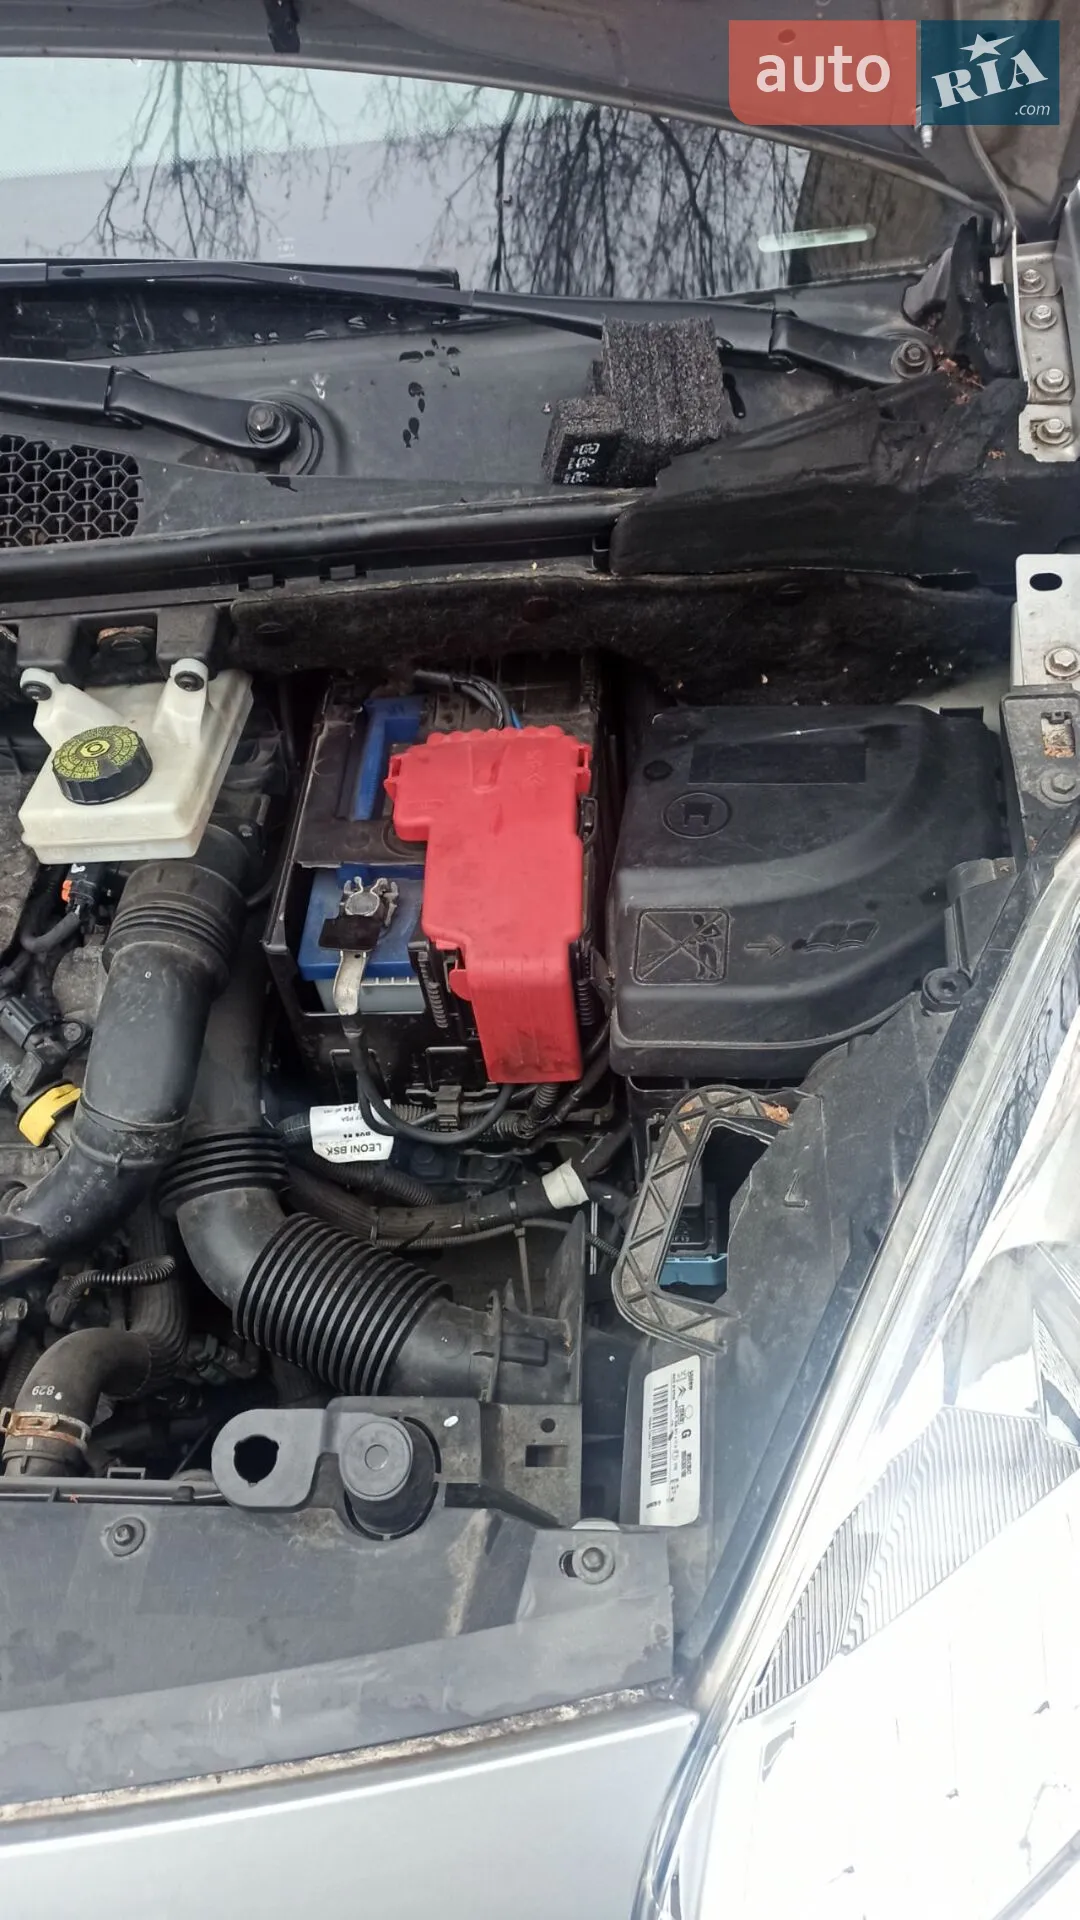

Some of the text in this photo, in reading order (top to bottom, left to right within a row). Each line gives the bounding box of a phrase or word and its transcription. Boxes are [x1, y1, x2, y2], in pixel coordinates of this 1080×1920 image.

[326, 1143, 382, 1156] LEONI BSK
[31, 1385, 55, 1396] 829
[681, 1428, 692, 1439] G
